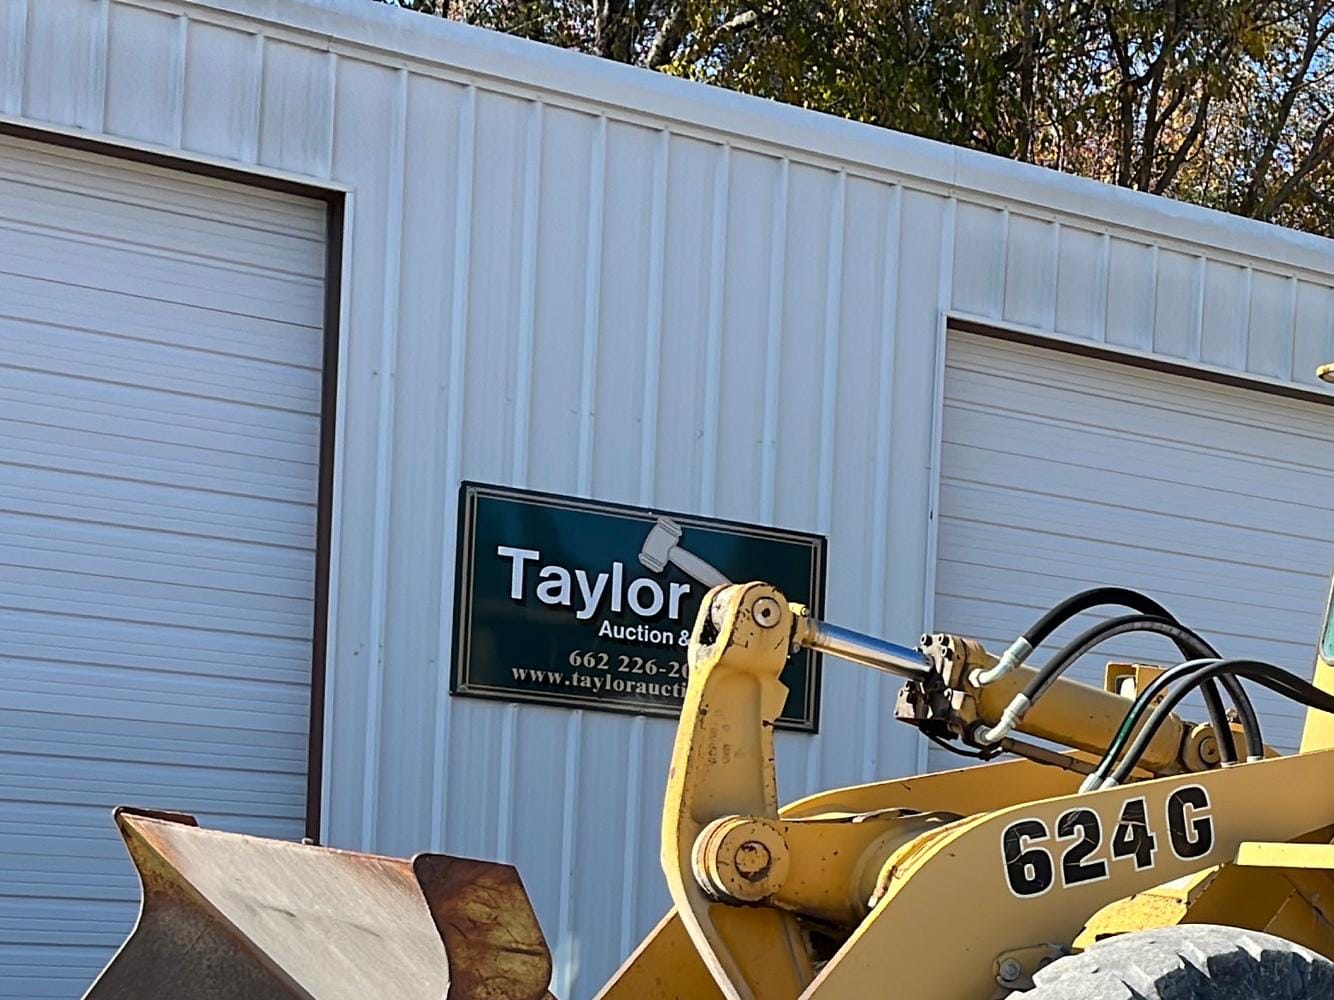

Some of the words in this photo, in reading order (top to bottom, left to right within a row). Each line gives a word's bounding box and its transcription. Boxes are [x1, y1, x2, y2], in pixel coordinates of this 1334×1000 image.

[498, 546, 691, 620] Taylor
[599, 620, 674, 645] Auction
[678, 630, 691, 646] &
[569, 650, 609, 670] 662
